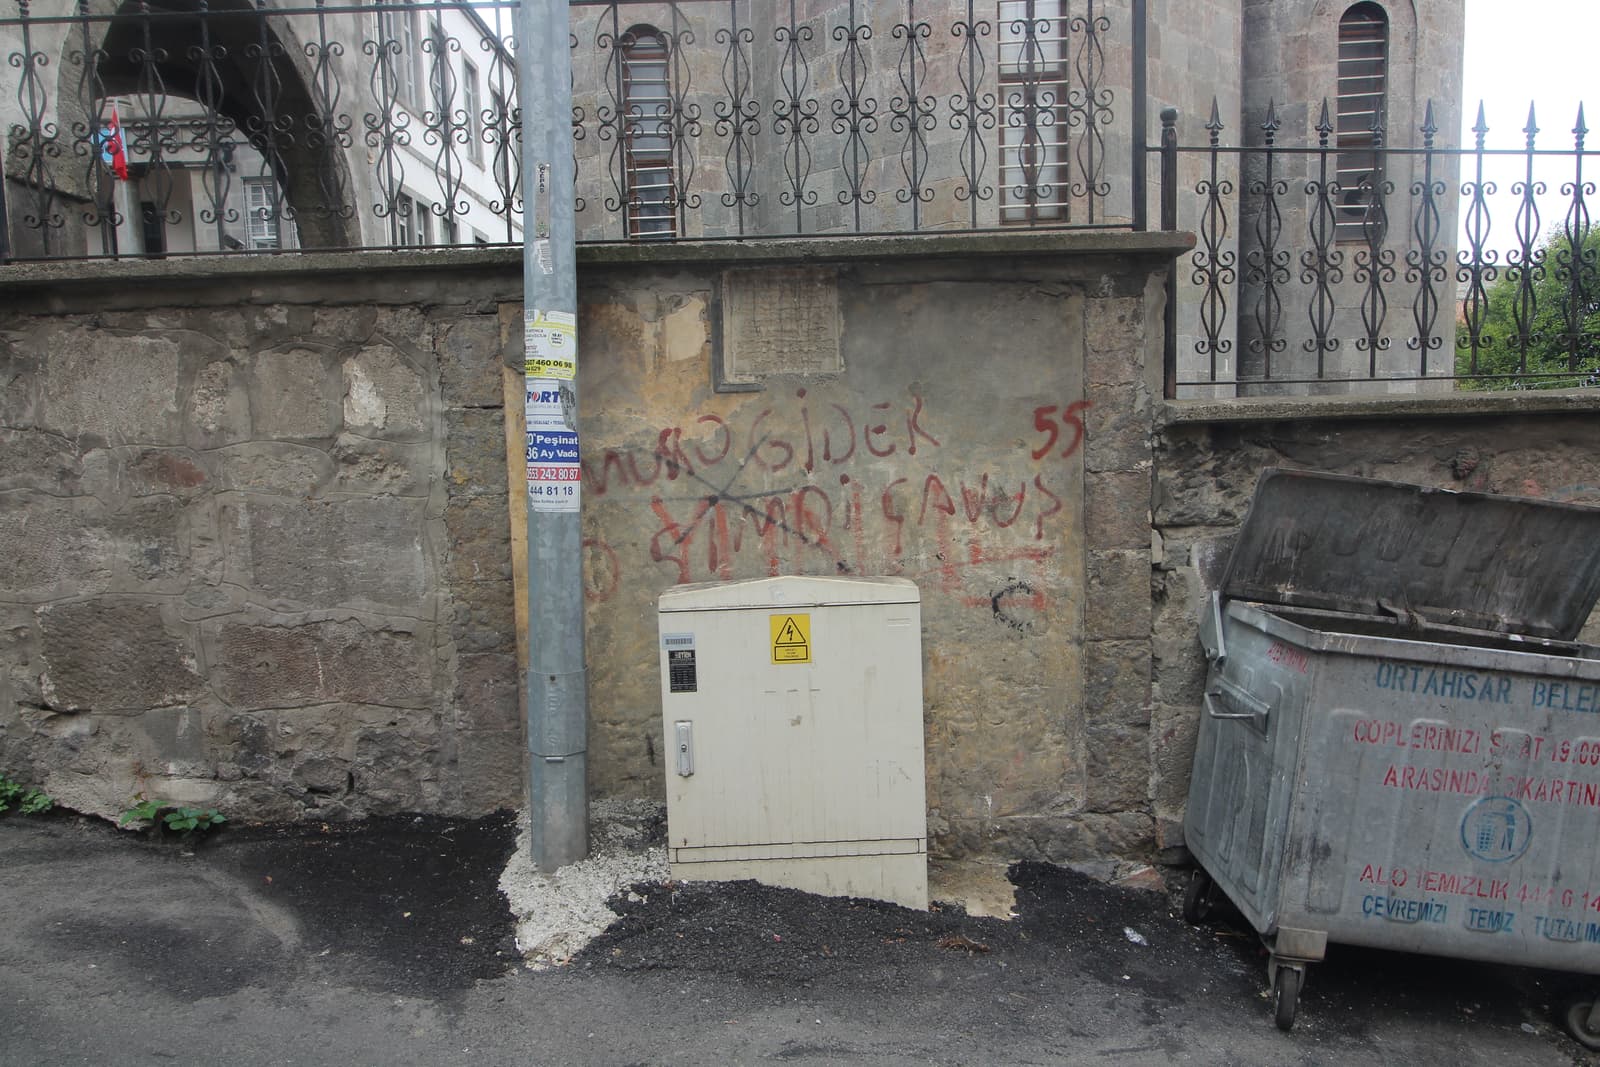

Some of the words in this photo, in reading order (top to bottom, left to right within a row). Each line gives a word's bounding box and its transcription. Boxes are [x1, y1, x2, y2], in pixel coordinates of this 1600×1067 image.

[536, 434, 579, 447] Peşinat
[541, 449, 555, 459] Ay
[557, 449, 578, 458] Vade
[540, 469, 557, 480] 242
[558, 469, 569, 480] 80
[569, 469, 579, 480] 87
[546, 486, 558, 496] 81
[563, 486, 574, 496] 18
[1383, 765, 1490, 795] ARASINDA
[1360, 864, 1408, 888] ALO
